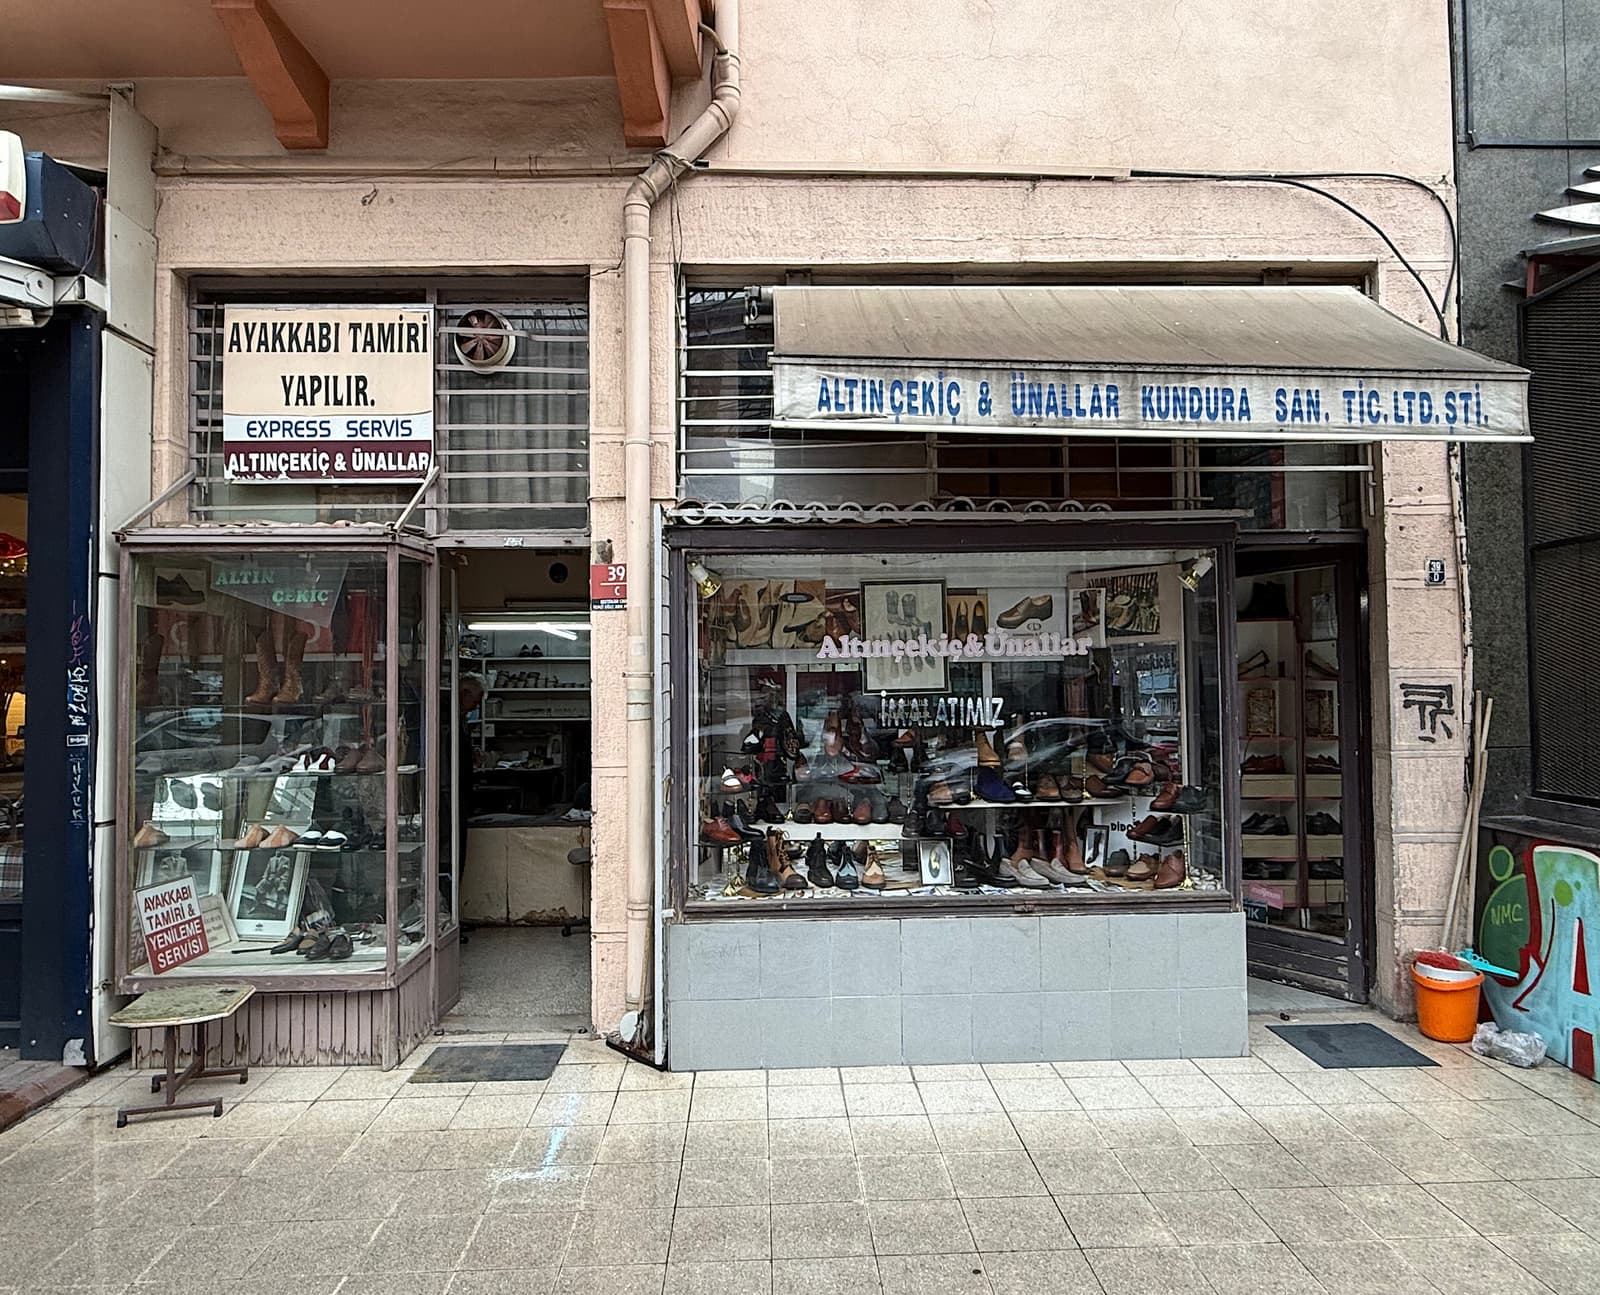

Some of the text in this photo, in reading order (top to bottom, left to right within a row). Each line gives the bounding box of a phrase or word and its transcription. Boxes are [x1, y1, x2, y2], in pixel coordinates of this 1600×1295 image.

[228, 314, 428, 353] AYAKKABI TAMİRİ
[281, 375, 376, 407] YAPILIR.
[817, 371, 961, 424] ALTINÇEKİÇ
[978, 381, 992, 416] &
[1010, 371, 1120, 419] ÜNALLAR
[1141, 384, 1251, 422] KUNDURA
[1276, 387, 1330, 423] SAN.
[246, 417, 413, 438] EXPRESS SERVİS
[229, 447, 429, 476] ALTINÇEKİÇ & ÜNALLAR
[215, 568, 275, 585] ALTIN
[608, 565, 626, 582] 39
[614, 586, 620, 596] C
[880, 690, 1005, 728] İMALATIMIZ
[144, 885, 192, 912] AYAKKABI
[146, 903, 185, 931] TAMİRİ
[188, 904, 196, 918] &
[149, 920, 202, 951] YENİLEME
[157, 937, 203, 968] SERVİSİ
